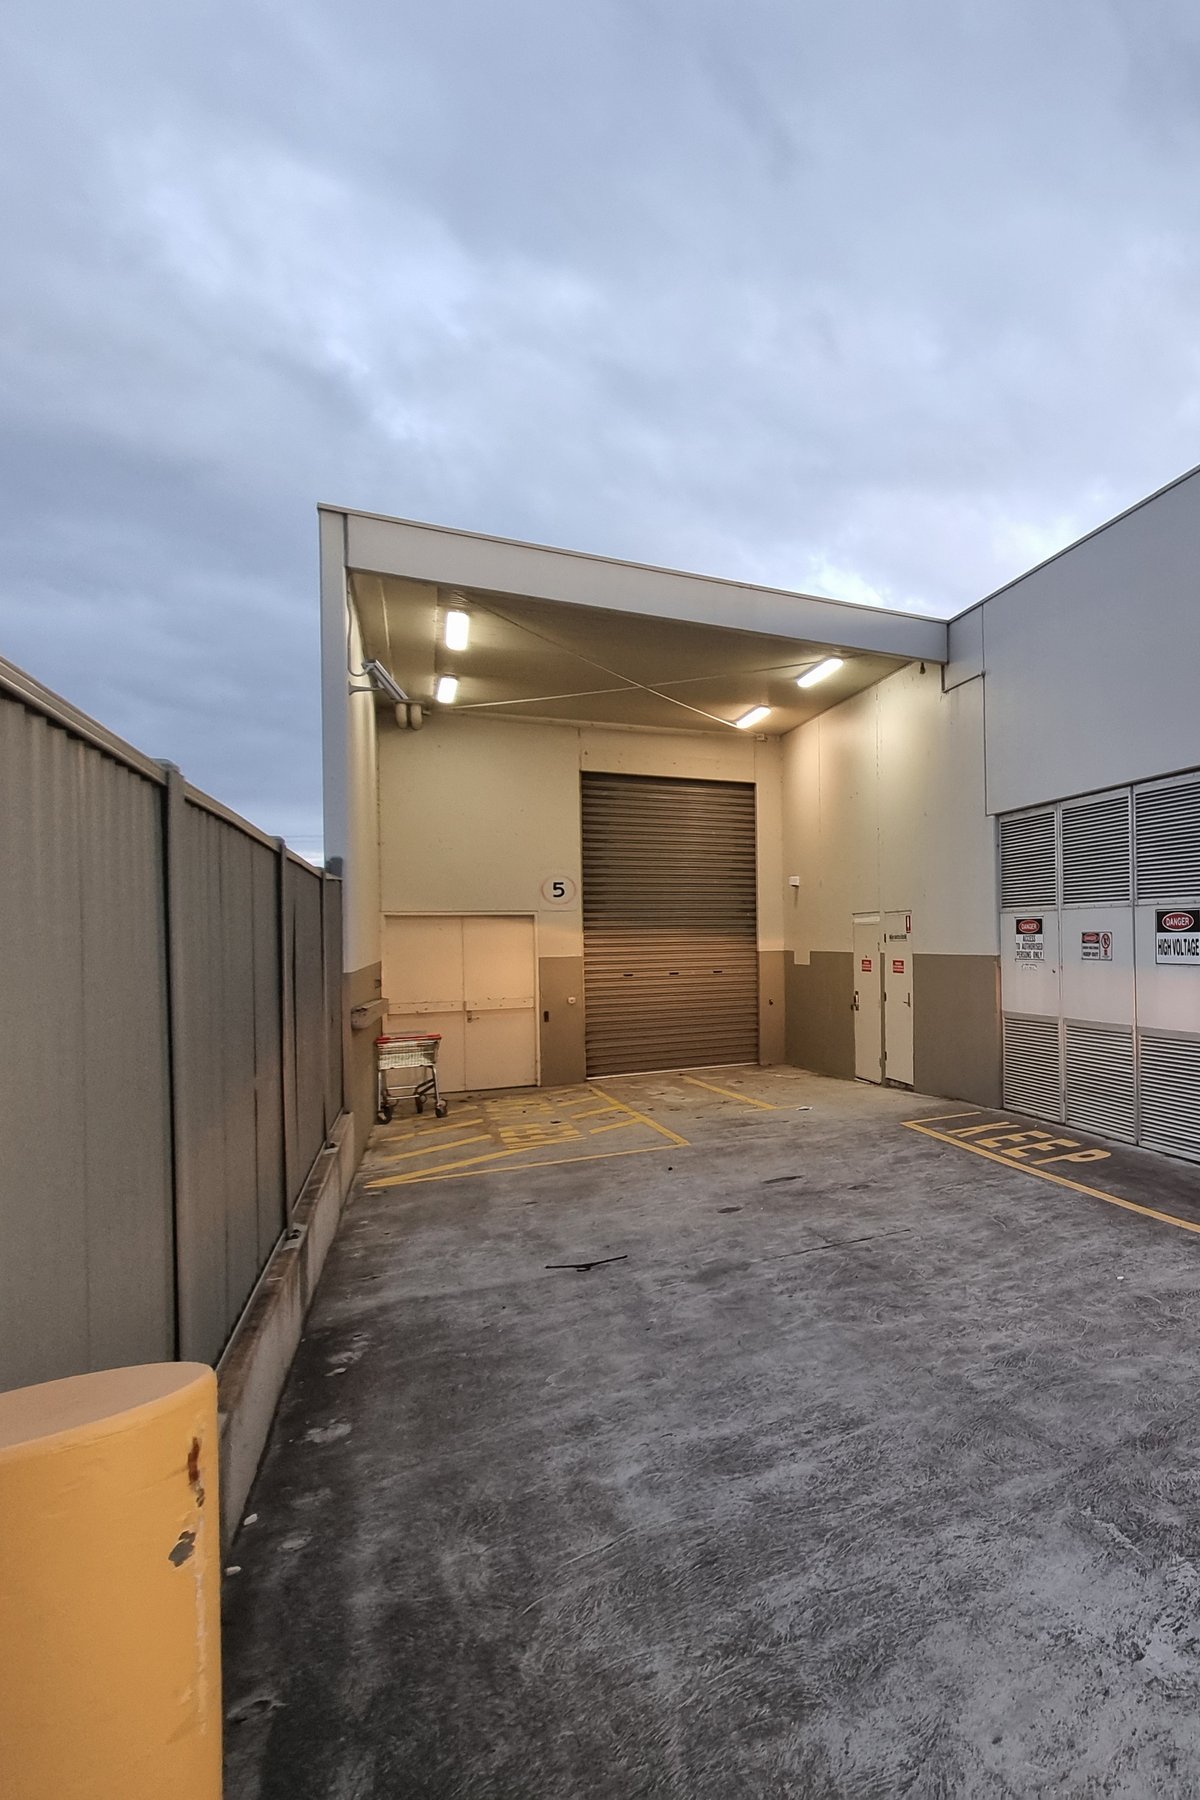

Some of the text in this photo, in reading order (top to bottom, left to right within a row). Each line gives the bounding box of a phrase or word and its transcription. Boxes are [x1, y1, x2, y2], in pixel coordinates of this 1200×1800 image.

[552, 881, 567, 898] 5
[1165, 917, 1190, 926] DANGER
[1033, 951, 1043, 959] ONLY
[1158, 938, 1200, 956] HIGH VOLTAGE
[946, 1121, 1111, 1166] KEEP
